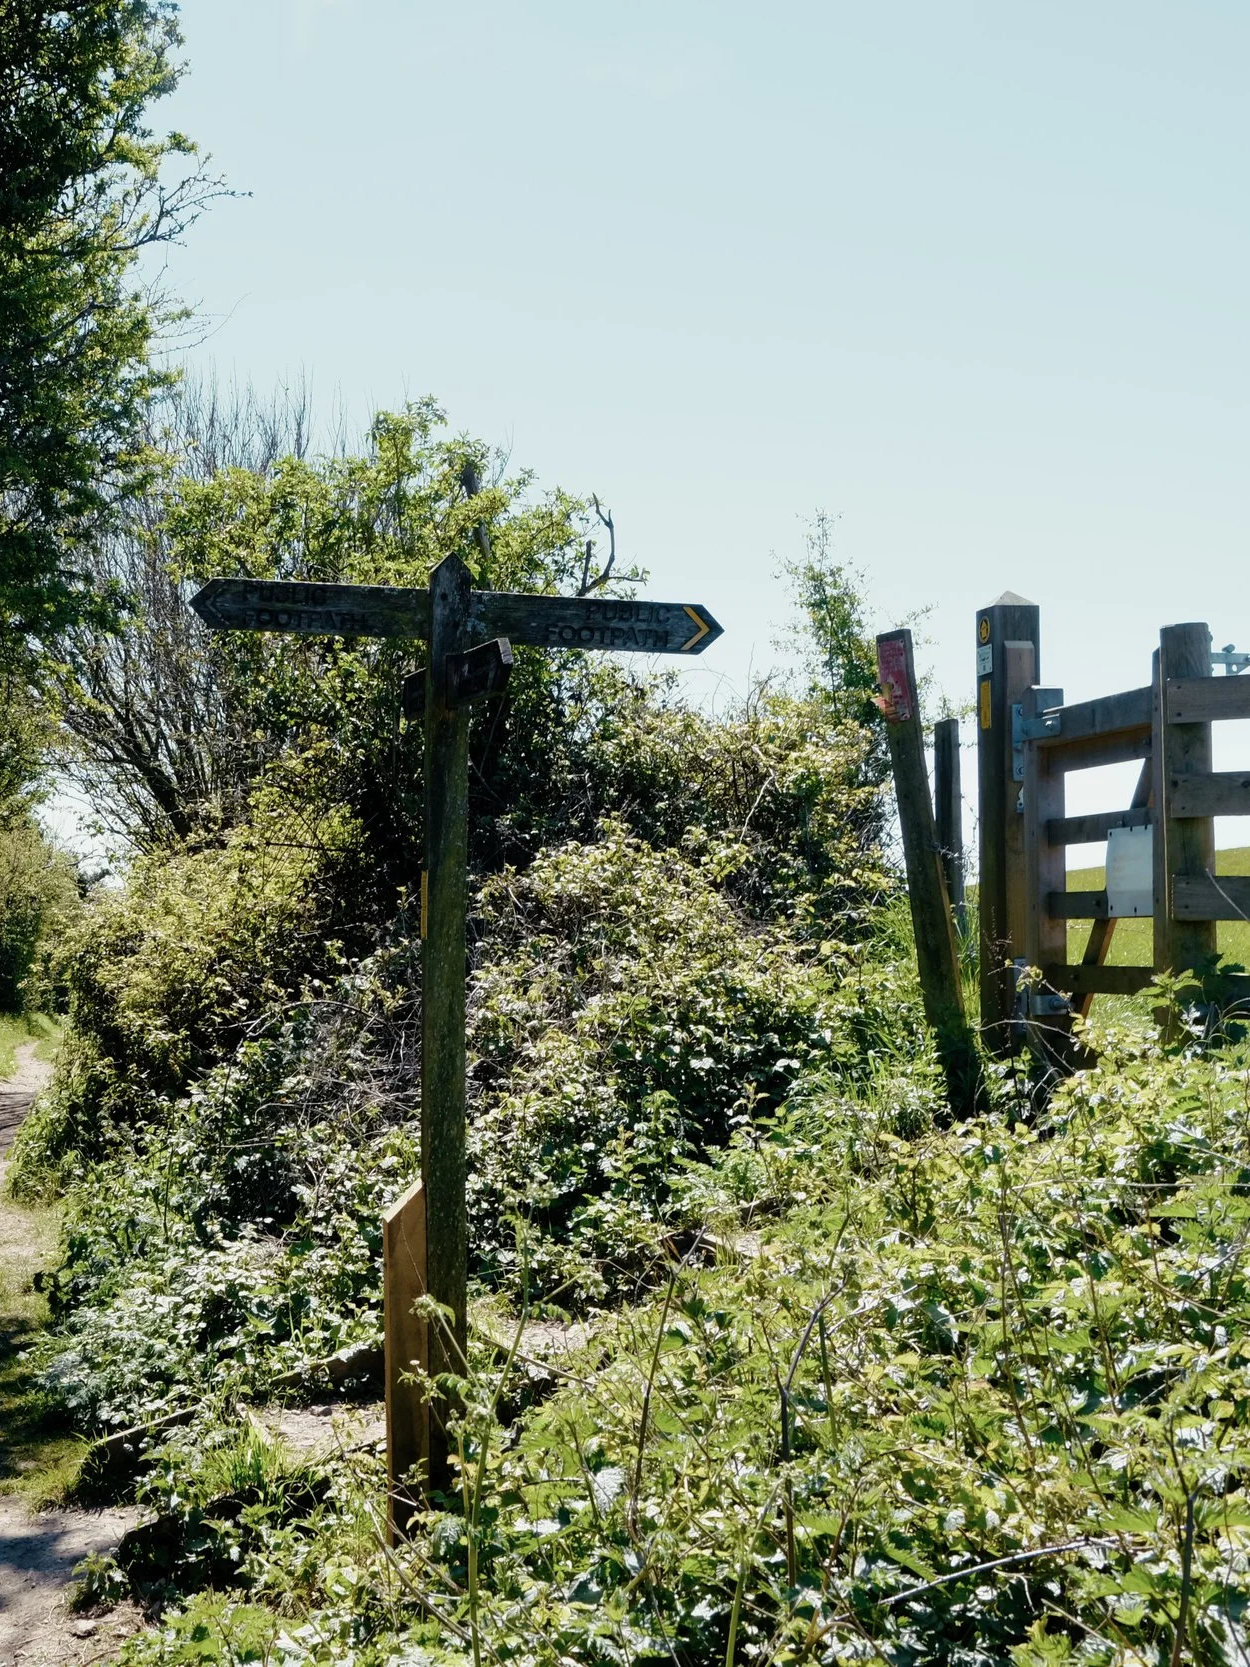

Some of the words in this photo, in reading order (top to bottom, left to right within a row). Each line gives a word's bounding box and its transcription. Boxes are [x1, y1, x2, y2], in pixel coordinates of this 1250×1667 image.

[240, 584, 327, 605] PUBLIC
[242, 608, 367, 631] FOOTPATH
[586, 602, 671, 623] PUBLIC
[545, 624, 669, 647] FOOTPATH
